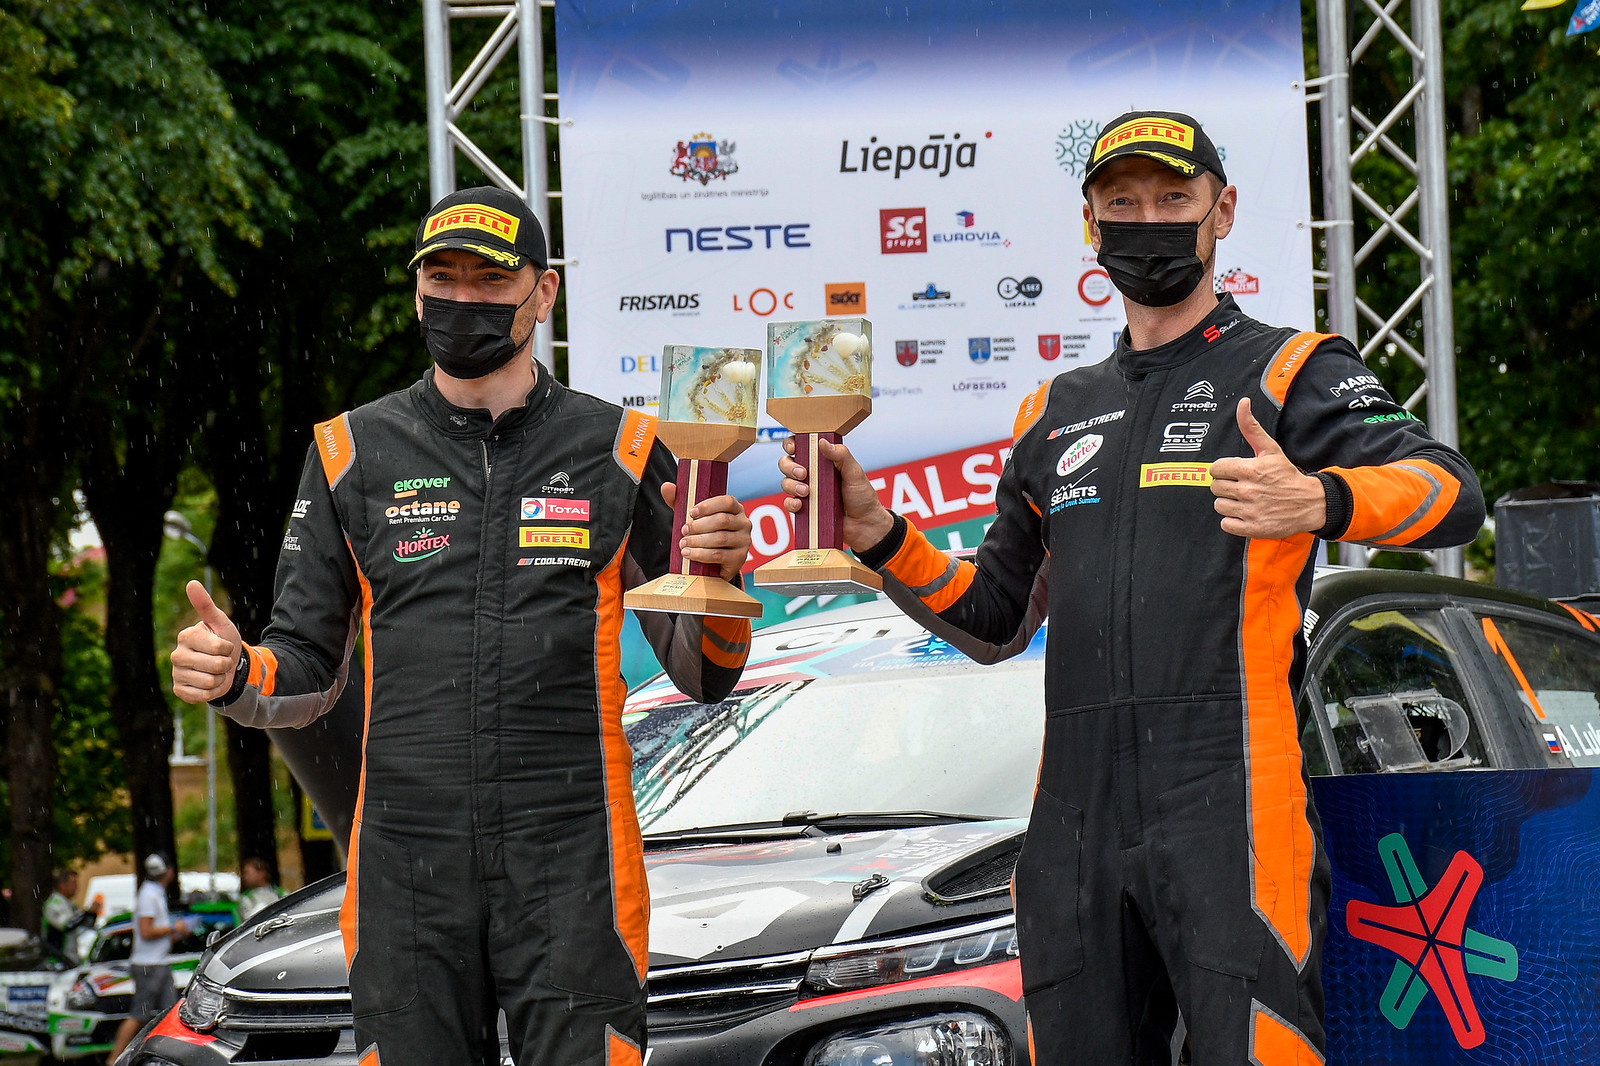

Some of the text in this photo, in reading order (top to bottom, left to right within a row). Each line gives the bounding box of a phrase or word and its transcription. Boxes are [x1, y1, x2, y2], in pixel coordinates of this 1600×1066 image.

[1100, 120, 1187, 152] PIRELLI
[840, 133, 977, 178] Liepāja
[429, 207, 512, 235] PIRELLI
[886, 215, 924, 239] SC
[665, 223, 811, 253] NESTE
[933, 231, 1001, 243] EUROVIA
[619, 293, 700, 311] FRISTADS
[1277, 339, 1315, 378] MARINA
[1330, 375, 1381, 398] MARIN
[1064, 410, 1126, 435] COOLSTREAM
[322, 423, 340, 460] MARINA
[628, 417, 651, 458] MARINA
[1060, 439, 1098, 472] Hortex
[394, 476, 451, 493] ekover
[1146, 466, 1208, 482] PIRELLI
[1050, 485, 1098, 507] SEAJETS
[1078, 497, 1102, 505] Summer
[385, 500, 461, 518] octane
[389, 517, 403, 525] Rent
[403, 516, 430, 524] Premium
[442, 514, 457, 522] Club
[395, 533, 451, 557] HORTEX
[525, 530, 584, 545] PIRELLI
[534, 557, 591, 568] COOLSTREAM
[870, 657, 972, 672] CHAMPIONSH
[878, 654, 950, 667] EUROPEAN
